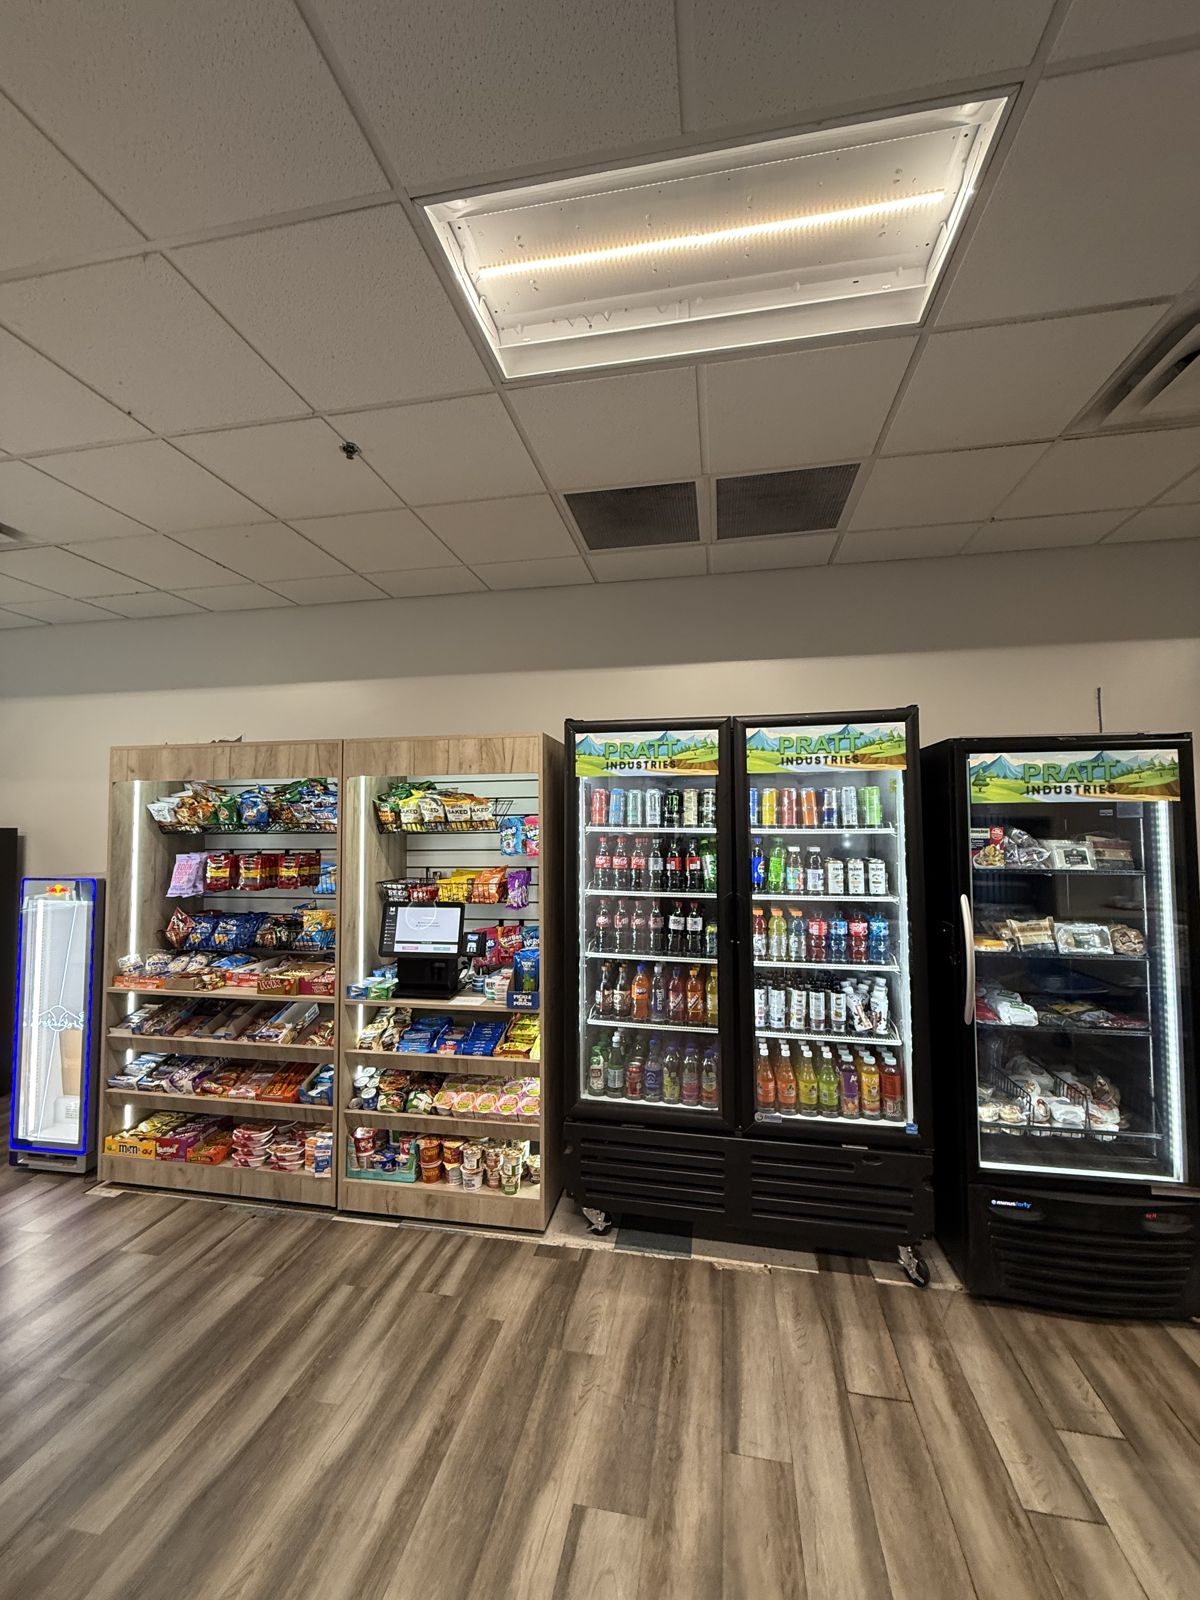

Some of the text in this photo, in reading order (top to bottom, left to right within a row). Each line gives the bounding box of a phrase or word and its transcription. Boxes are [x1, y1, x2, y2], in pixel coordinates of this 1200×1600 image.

[604, 739, 679, 760] PRATT
[779, 734, 861, 754] PRATT
[606, 760, 676, 770] INDUSTRIES
[781, 755, 860, 765] INDUSTRIES
[1023, 760, 1117, 783] PRATT
[1026, 784, 1117, 796] INDUSTRIES
